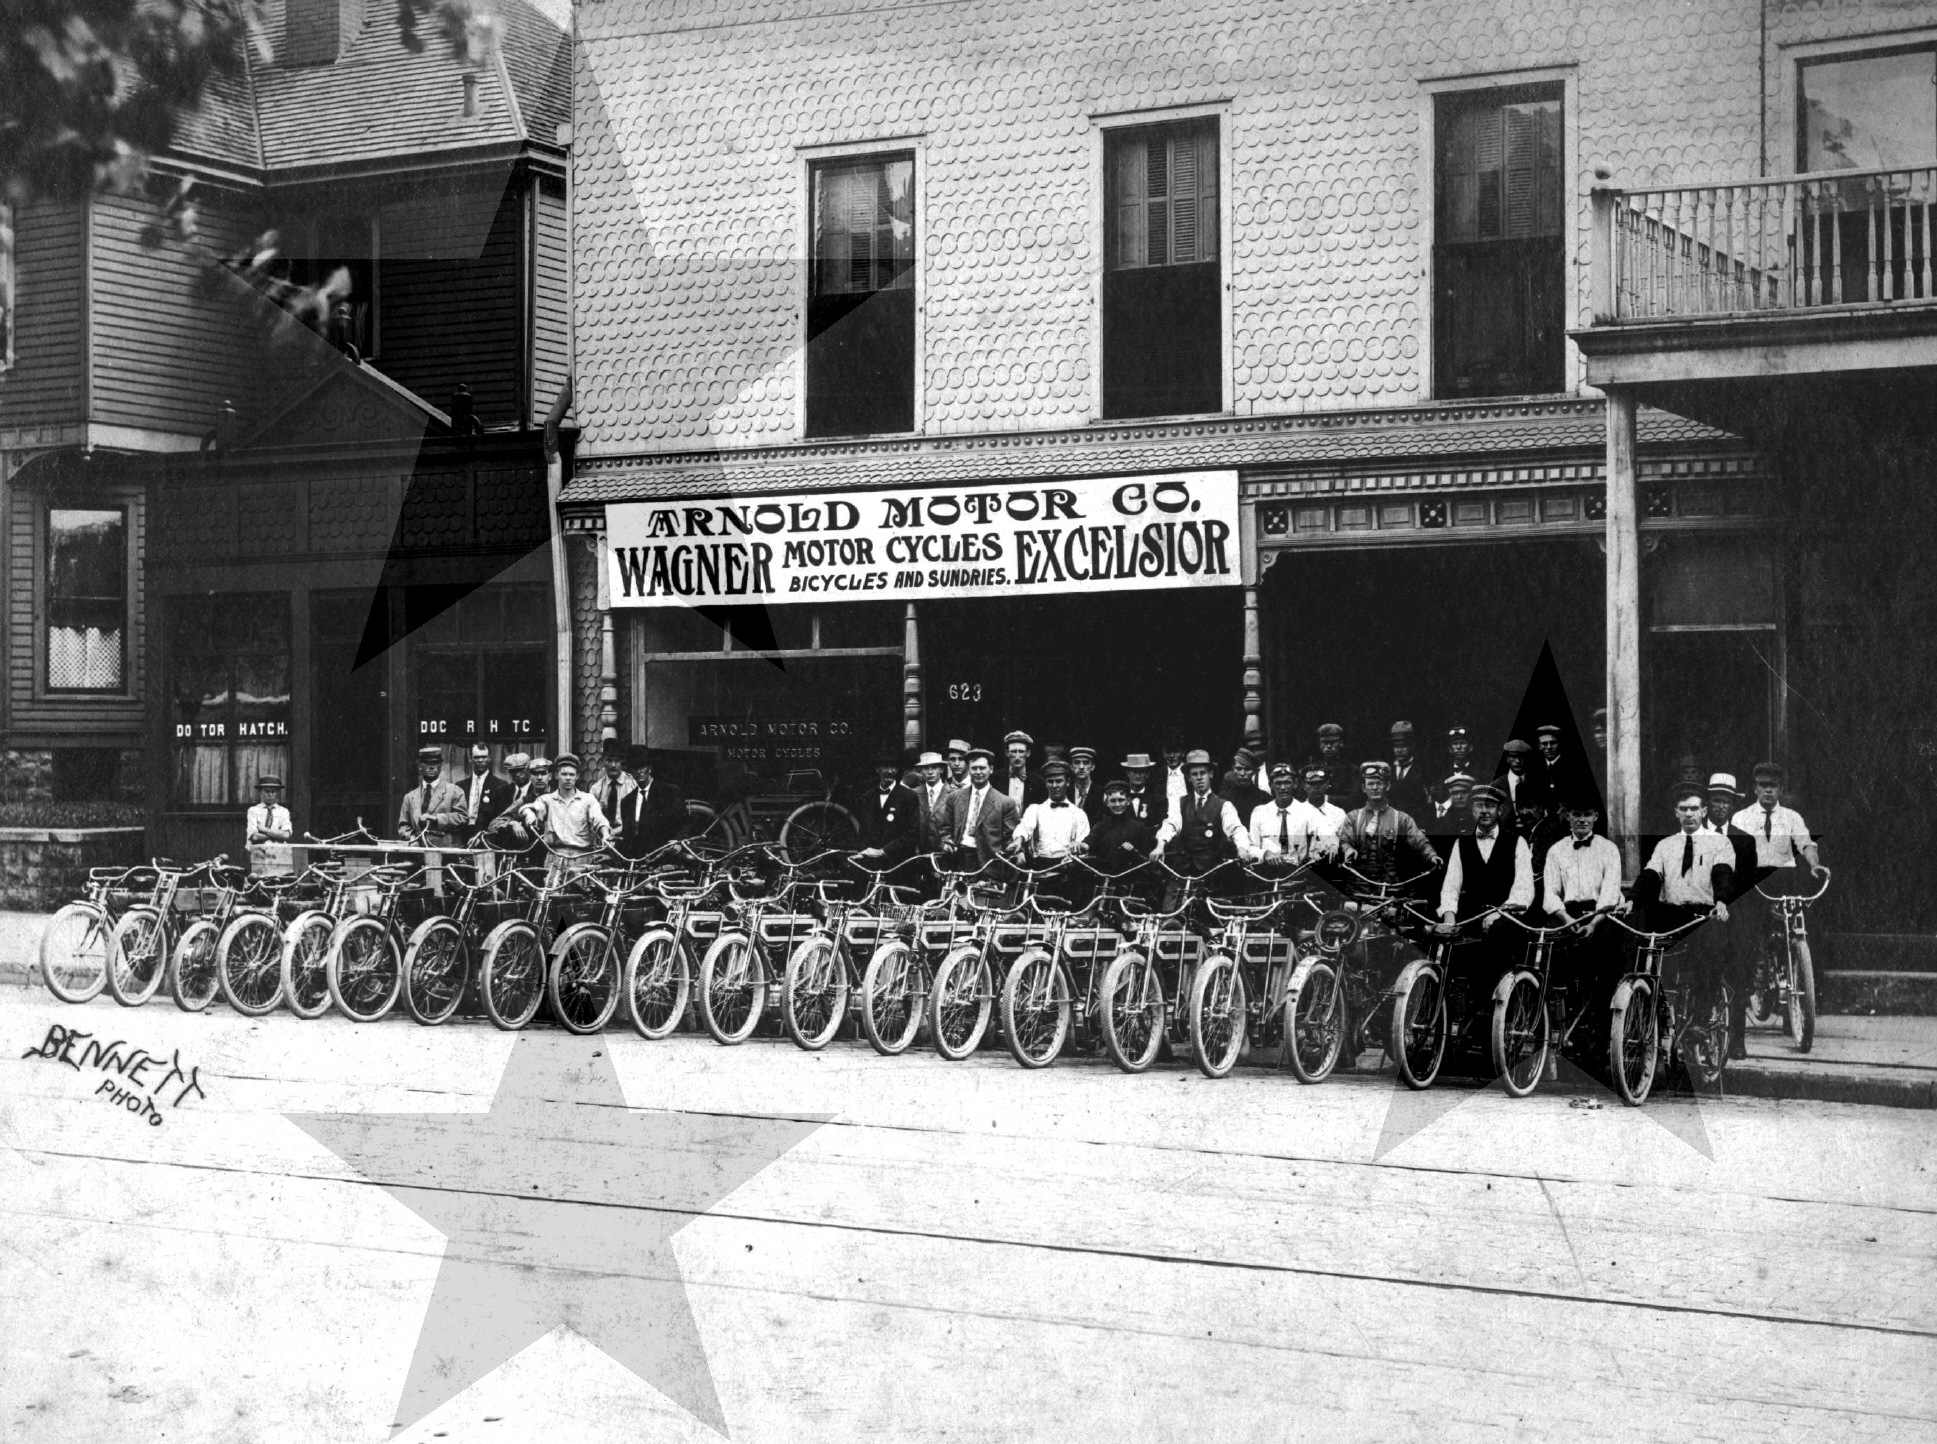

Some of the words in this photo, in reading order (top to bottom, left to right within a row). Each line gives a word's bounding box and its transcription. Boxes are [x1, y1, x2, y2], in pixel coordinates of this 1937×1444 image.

[645, 501, 860, 538] ARNOLD
[878, 489, 1087, 528] MOTOR
[1112, 481, 1201, 516] CO.
[783, 538, 875, 568] MOTOR
[886, 532, 1003, 564] CYCLES
[1014, 519, 1231, 585] EXCELSIOR
[614, 542, 775, 597] WAGNER
[788, 572, 889, 593] BICYCLES
[894, 569, 926, 589] AND
[927, 567, 1011, 588] SUNDRIES.
[948, 684, 982, 702] 623
[239, 721, 289, 736] HATCH.
[700, 723, 757, 736] ARNOLD
[767, 722, 818, 735] MOTOR
[829, 721, 853, 735] CO.
[727, 747, 765, 759] MOTOR
[775, 746, 820, 759] CYCLES
[95, 1079, 162, 1126] PHOTO
